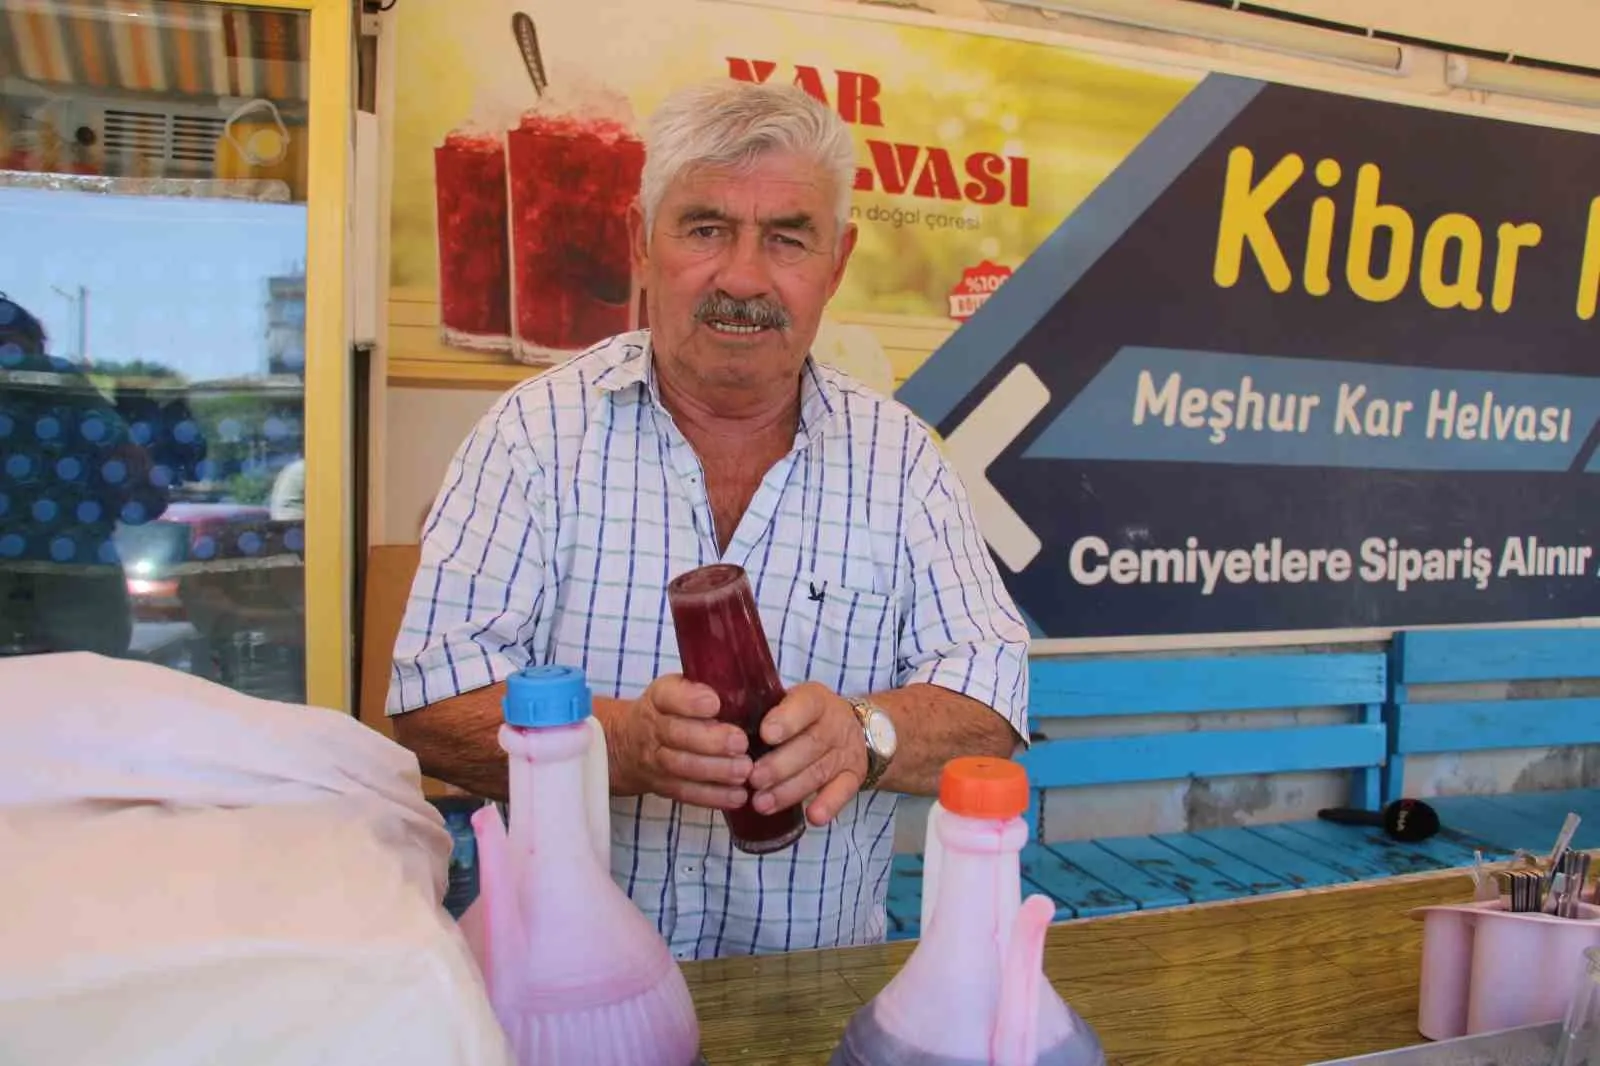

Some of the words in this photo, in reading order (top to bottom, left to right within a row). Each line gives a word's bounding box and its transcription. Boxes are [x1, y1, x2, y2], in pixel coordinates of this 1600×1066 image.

[866, 204, 920, 229] doğal
[925, 213, 980, 231] çaresi
[1213, 146, 1542, 313] Kibar
[1132, 369, 1321, 445] Meşhur
[1334, 383, 1414, 437] Kar
[1425, 389, 1571, 443] Helvası
[1069, 535, 1352, 595] Cemiyetlere
[1359, 536, 1492, 591] Sipariş
[1498, 536, 1592, 577] Alınır
